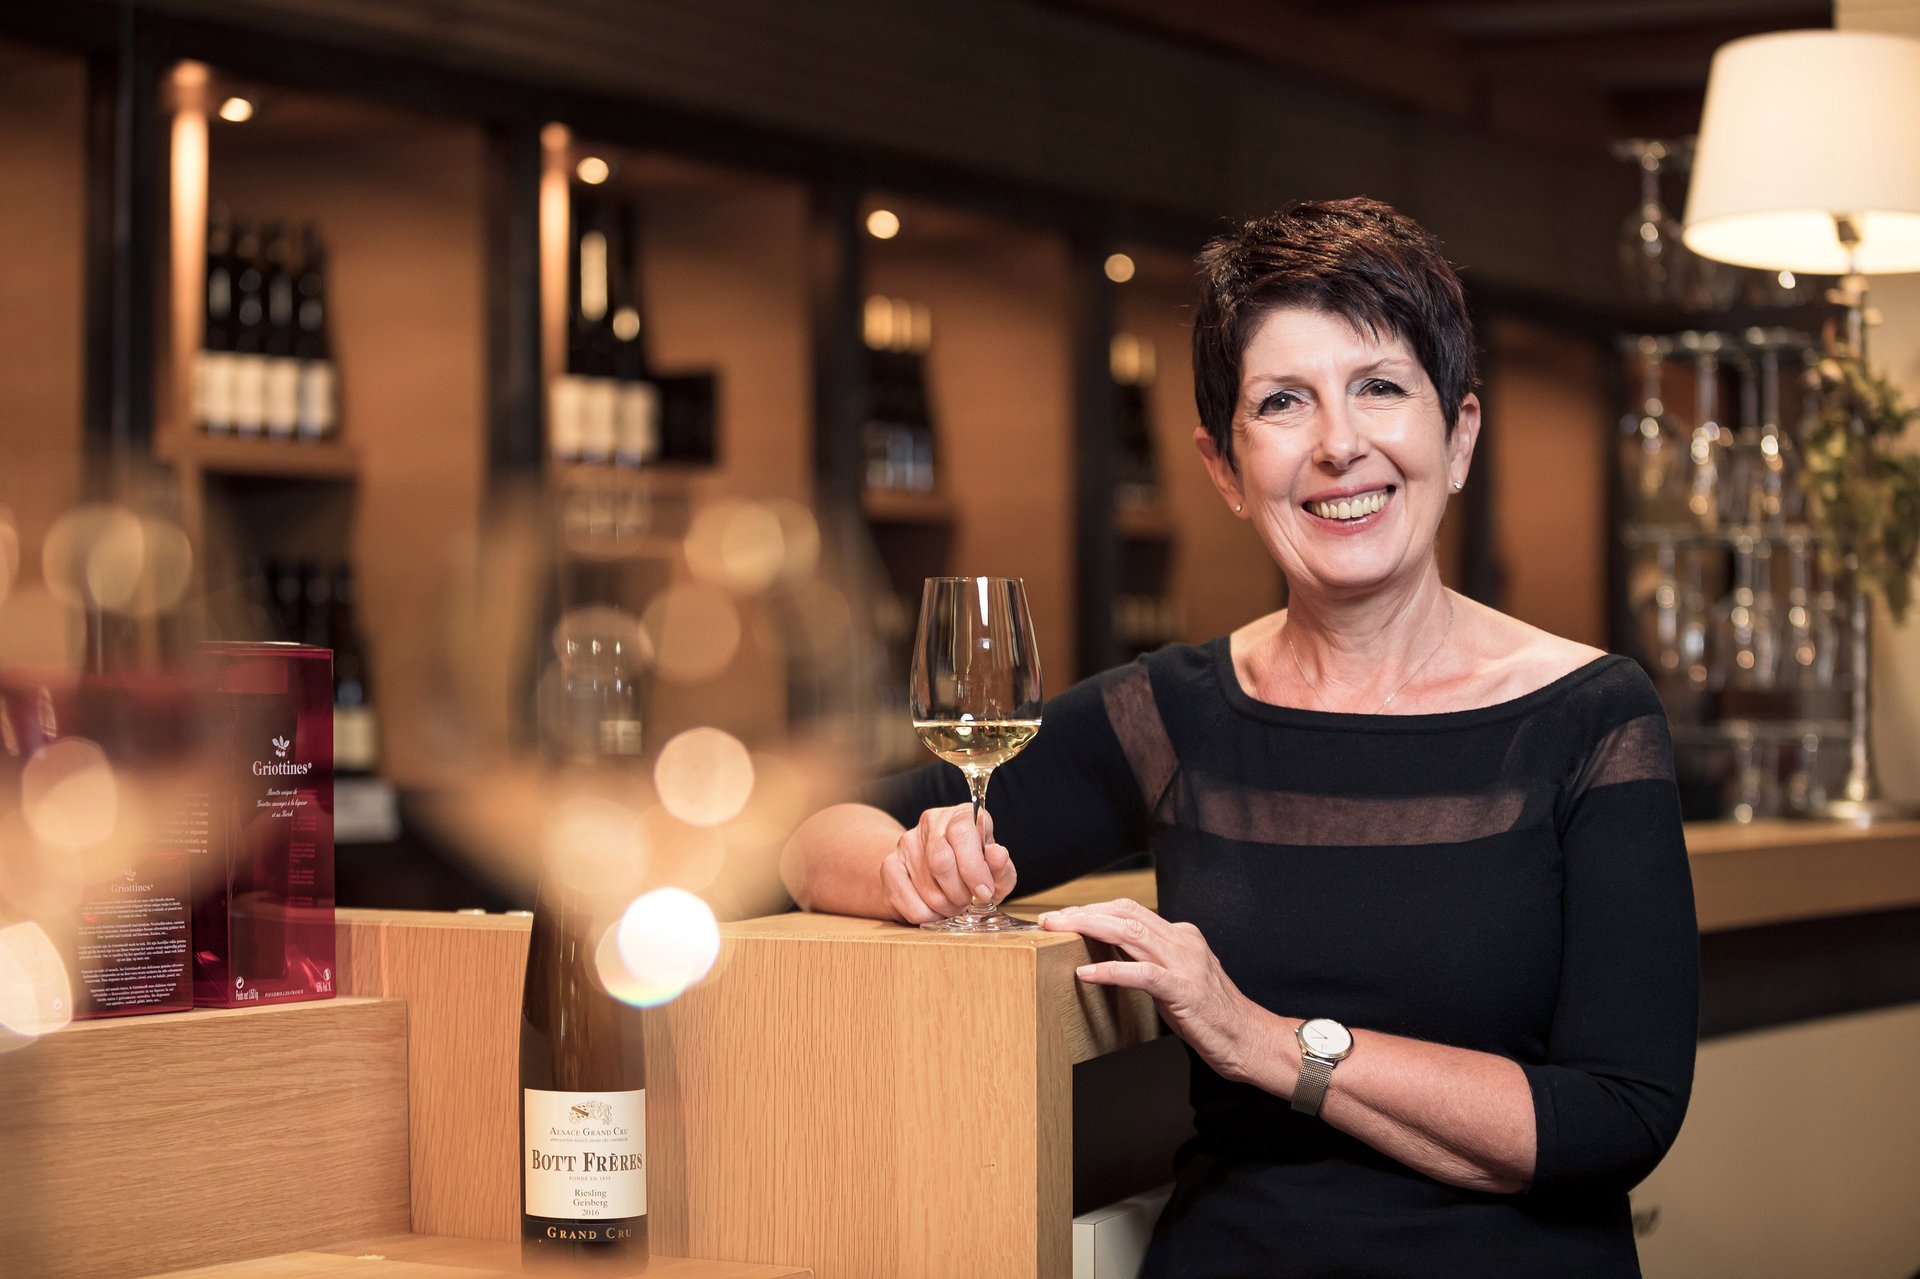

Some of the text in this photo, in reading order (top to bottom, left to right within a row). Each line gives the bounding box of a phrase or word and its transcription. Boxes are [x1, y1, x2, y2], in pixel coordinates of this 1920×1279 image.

[550, 1126, 629, 1137] ALSACE GRAND CRU
[531, 1149, 643, 1173] BOTT FRÈRES
[574, 1188, 607, 1199] Riesling
[572, 1199, 609, 1209] Geisberg
[582, 1209, 600, 1217] 2016
[546, 1226, 633, 1240] GRAND CRU
